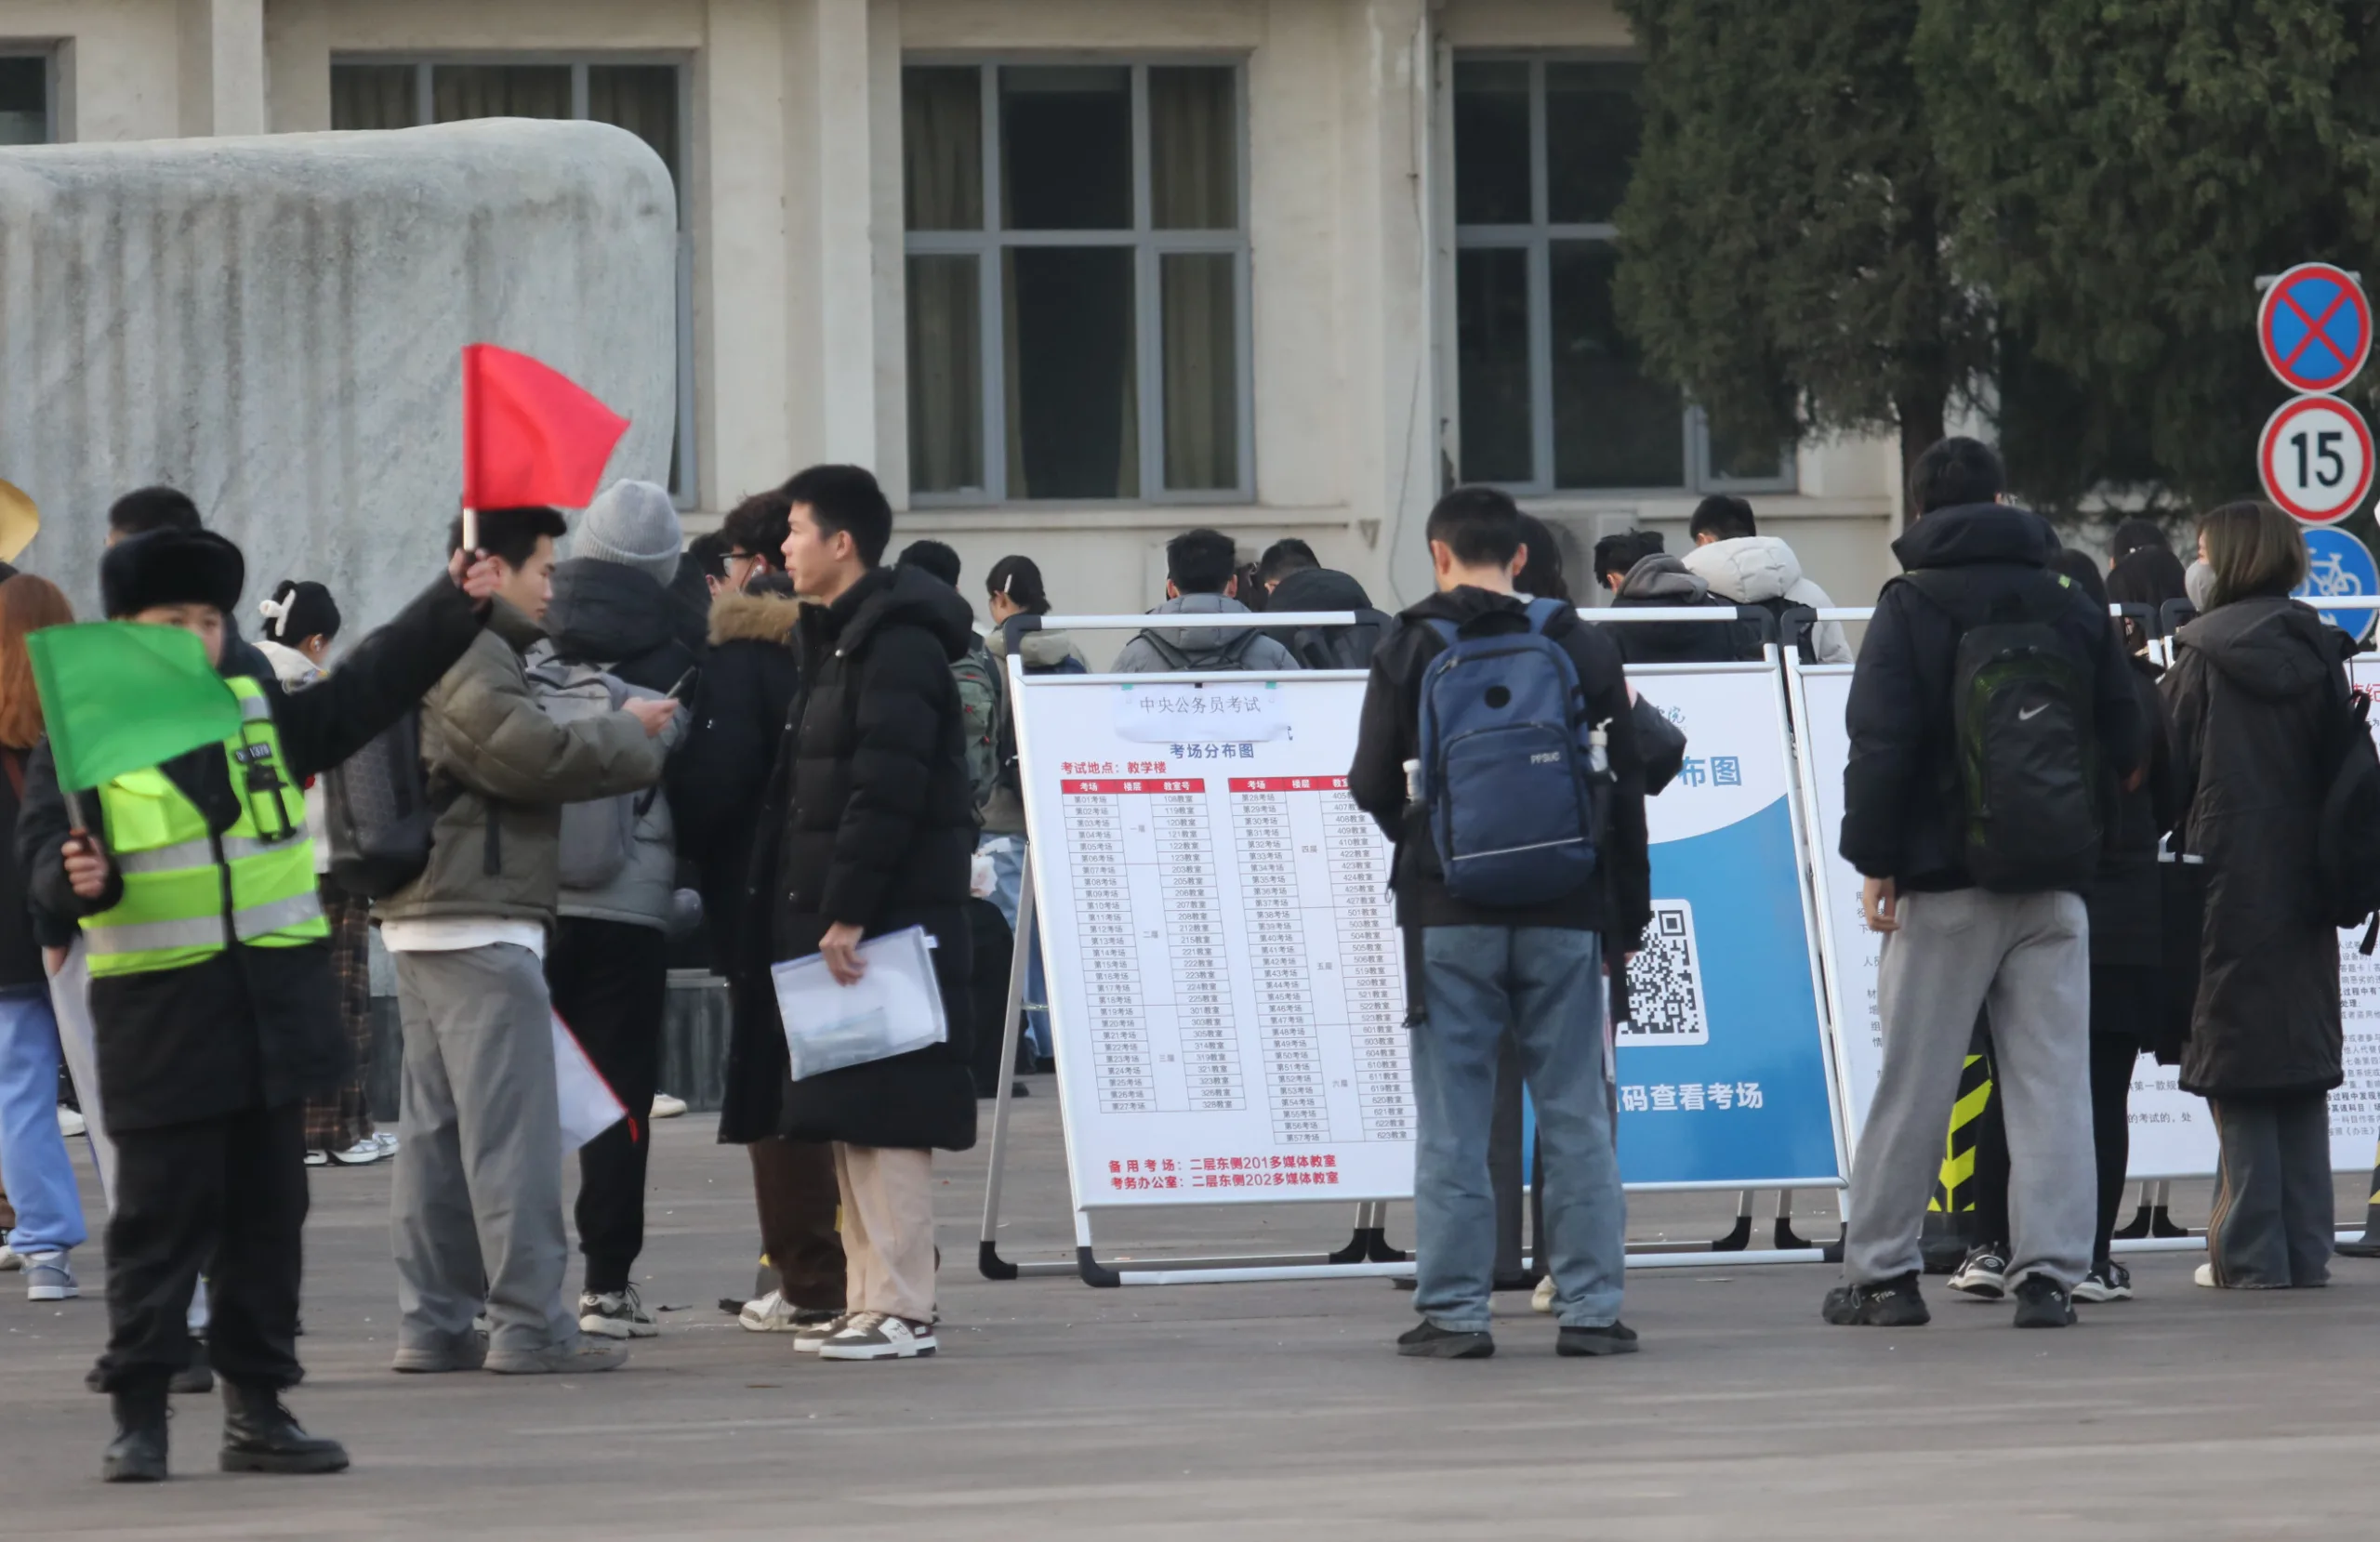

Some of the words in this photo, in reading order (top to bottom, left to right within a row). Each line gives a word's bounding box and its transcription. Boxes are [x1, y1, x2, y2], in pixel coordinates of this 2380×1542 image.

[2291, 431, 2345, 488] 15
[1139, 696, 1261, 714] 中央公务员考试
[1170, 744, 1254, 759] 考场分布图
[1079, 782, 1098, 791] 考场
[1123, 782, 1142, 791] 楼层
[1163, 782, 1190, 791] 教室号
[1247, 780, 1266, 789] 考场
[1291, 780, 1311, 789] 楼层
[1332, 779, 1349, 787] 教室
[2339, 988, 2380, 996] 过程中有
[2130, 1080, 2179, 1092] 第一款规
[1616, 1081, 1765, 1112] 码查看考场
